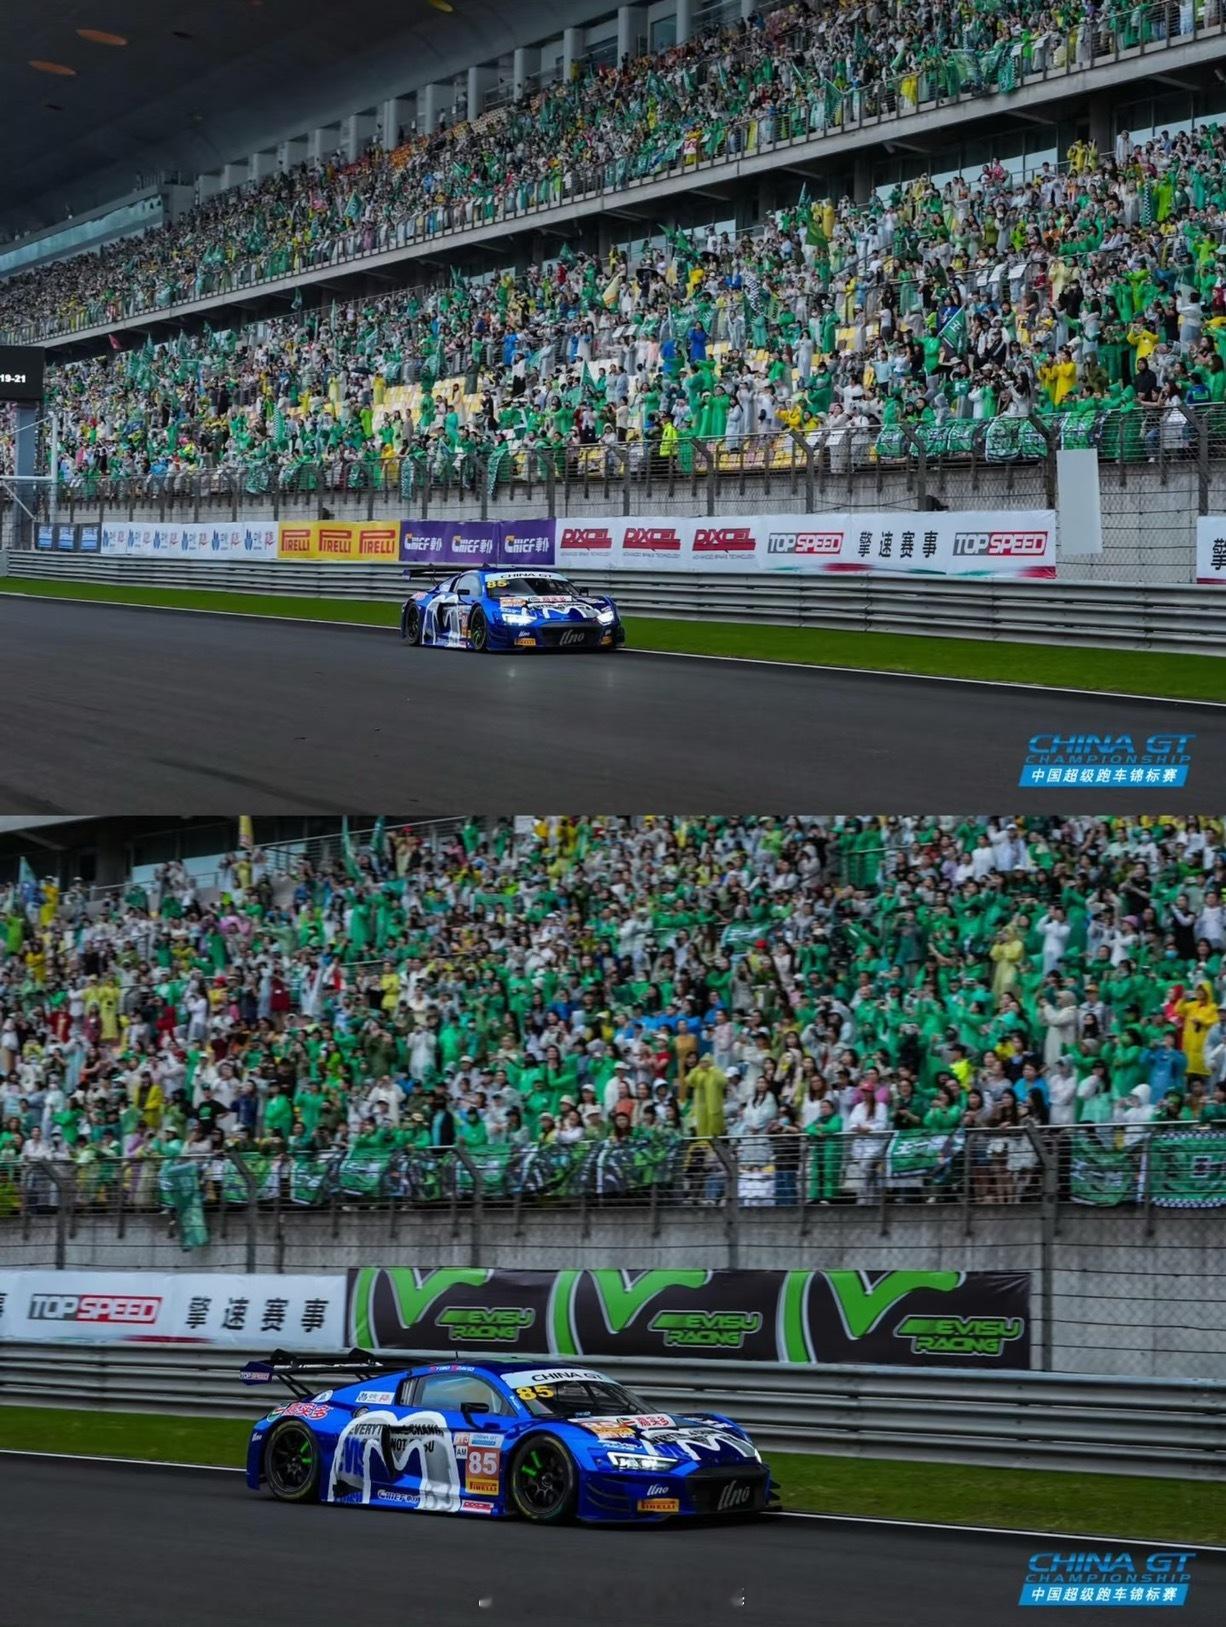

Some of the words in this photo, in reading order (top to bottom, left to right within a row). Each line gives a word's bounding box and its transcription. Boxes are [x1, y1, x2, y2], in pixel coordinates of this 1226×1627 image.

[281, 529, 311, 551] PIRELLI
[319, 529, 352, 553] PIRELLI
[360, 530, 396, 554] PIRELLI
[858, 530, 938, 558] 擎速赛事
[487, 580, 509, 589] 85
[185, 1296, 329, 1333] 擎速赛事
[685, 1314, 760, 1330] EVISU
[451, 1325, 516, 1339] RACING
[934, 1319, 1020, 1336] EVISU
[667, 1330, 740, 1345] RACING
[915, 1336, 1000, 1352] RACING
[532, 1372, 580, 1383] CHINA
[584, 1372, 604, 1381] GT
[516, 1385, 554, 1400] 85
[469, 1452, 497, 1475] 85
